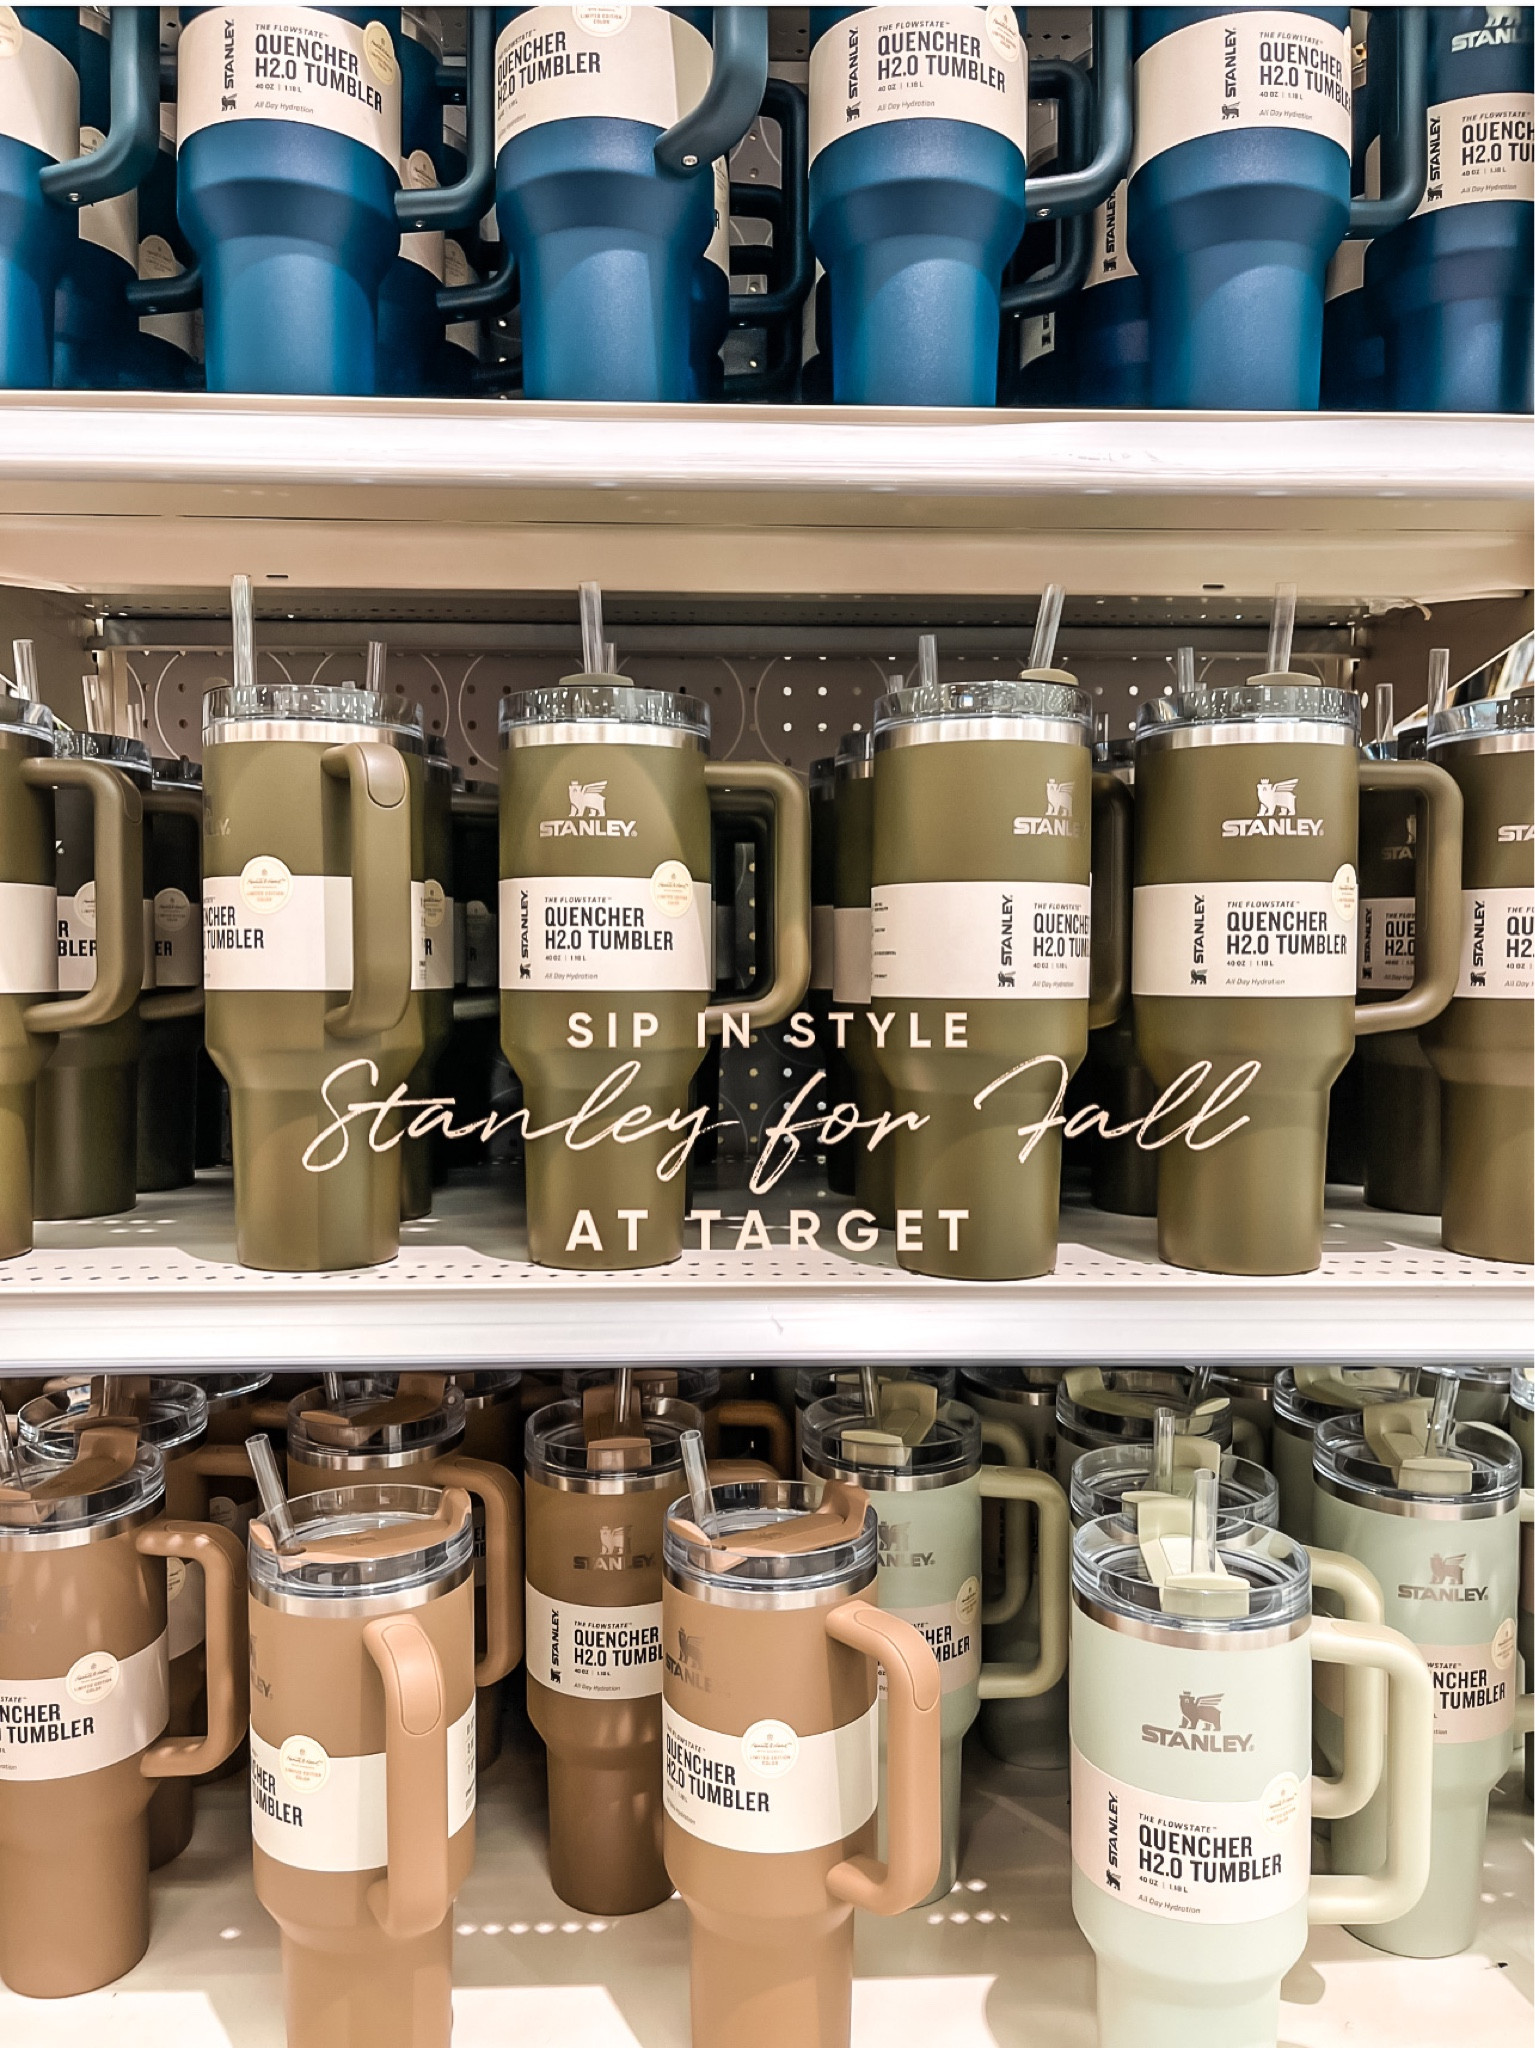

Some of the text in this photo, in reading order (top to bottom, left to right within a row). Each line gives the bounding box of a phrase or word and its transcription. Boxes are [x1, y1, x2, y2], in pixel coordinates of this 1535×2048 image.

[256, 34, 358, 76] QUENCHER
[498, 31, 566, 86] QUENCHER
[878, 31, 980, 59] QUENCHER
[519, 52, 600, 89] TUMBLER
[878, 54, 1006, 94] H2.0 TUMBLER
[1260, 42, 1342, 82] QUENCHER
[256, 57, 382, 114] H2.0 TUMBLER
[1260, 66, 1351, 116] H2.0 TUMBLE
[1462, 143, 1502, 166] H2.0
[545, 907, 644, 927] QUENCHER
[1227, 911, 1327, 932] QUENCHER
[207, 928, 264, 950] TUMBLER
[545, 930, 674, 950] H2.0 TUMBLER
[1033, 936, 1066, 958] H2.0
[1227, 934, 1347, 955] H2.0 TUMBLER
[574, 1626, 659, 1649] QUENCHER
[574, 1648, 607, 1667] H2.0
[1440, 1682, 1505, 1710] TUMBLER
[6, 1716, 94, 1744] TUMBLER
[666, 1733, 736, 1786] QUENCHER
[688, 1774, 770, 1812] TUMBLER
[1139, 1824, 1252, 1858] QUENCHER
[1139, 1848, 1282, 1883] H2.0 TUMBLER
